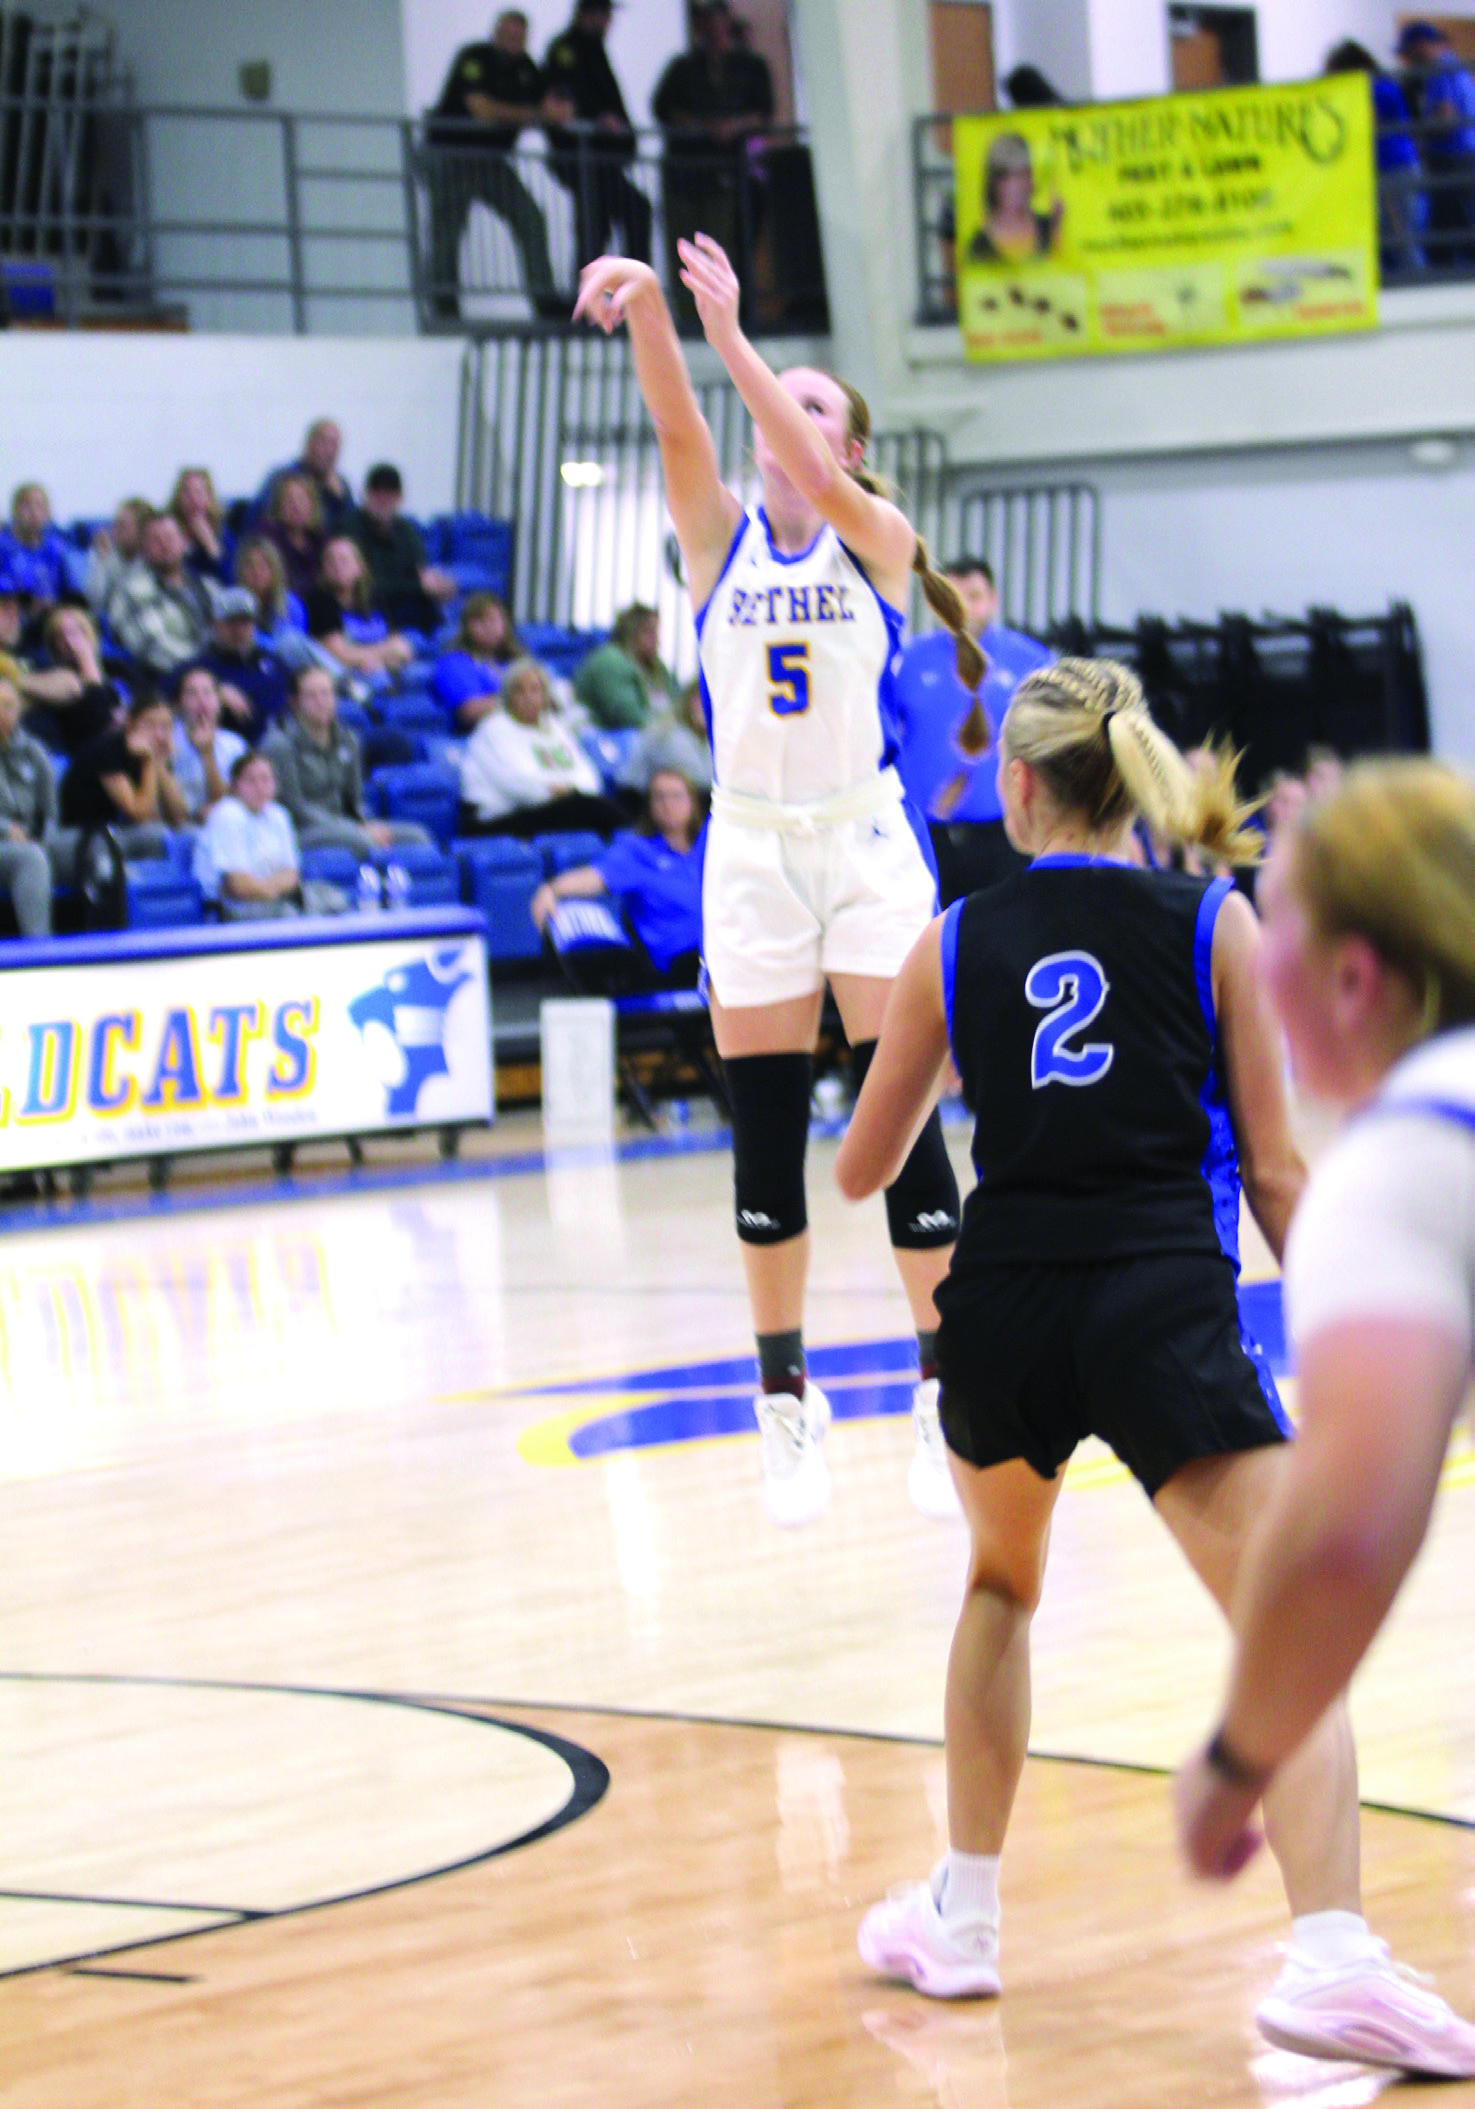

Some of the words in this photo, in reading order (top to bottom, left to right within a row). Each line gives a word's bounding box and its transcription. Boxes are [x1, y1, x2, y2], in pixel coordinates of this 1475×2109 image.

[729, 585, 855, 626] BETHEL
[765, 641, 811, 719] 5
[0, 995, 319, 1128] DCATS
[1024, 950, 1114, 1090] 2
